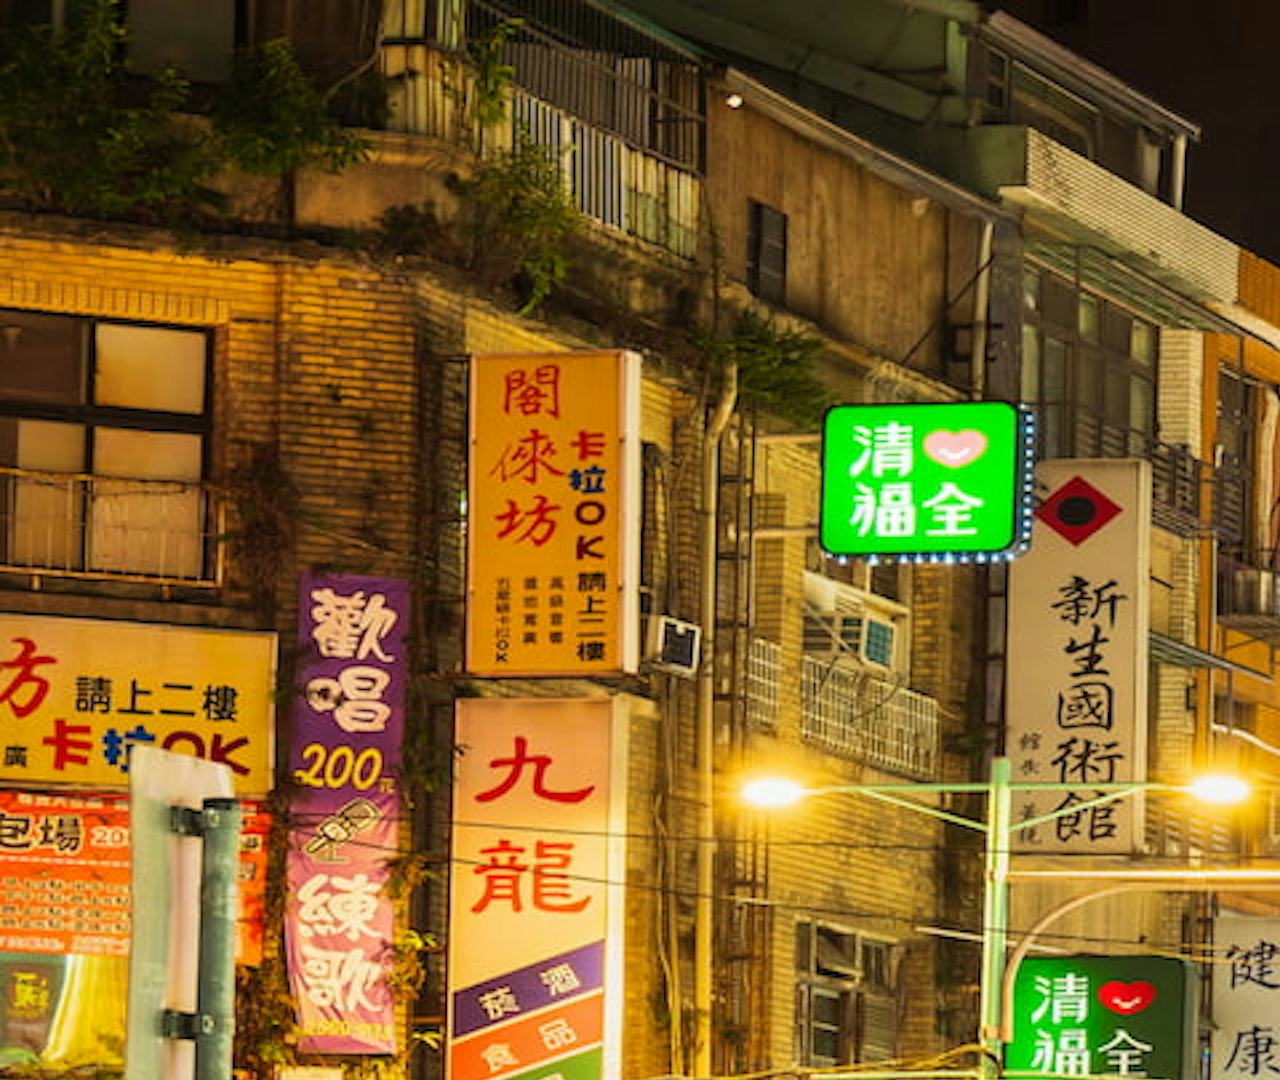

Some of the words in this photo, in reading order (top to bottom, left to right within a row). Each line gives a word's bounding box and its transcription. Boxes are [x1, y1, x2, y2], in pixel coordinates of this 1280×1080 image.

[849, 421, 914, 478] 清
[849, 482, 984, 537] 福全
[306, 587, 398, 734] 歡唱
[75, 676, 239, 723] 請上二樓
[1051, 575, 1128, 843] 新生國術館
[470, 736, 596, 914] 九龍
[1030, 972, 1090, 1025] 清
[479, 1019, 578, 1074] 食品
[1030, 1028, 1154, 1079] 福全
